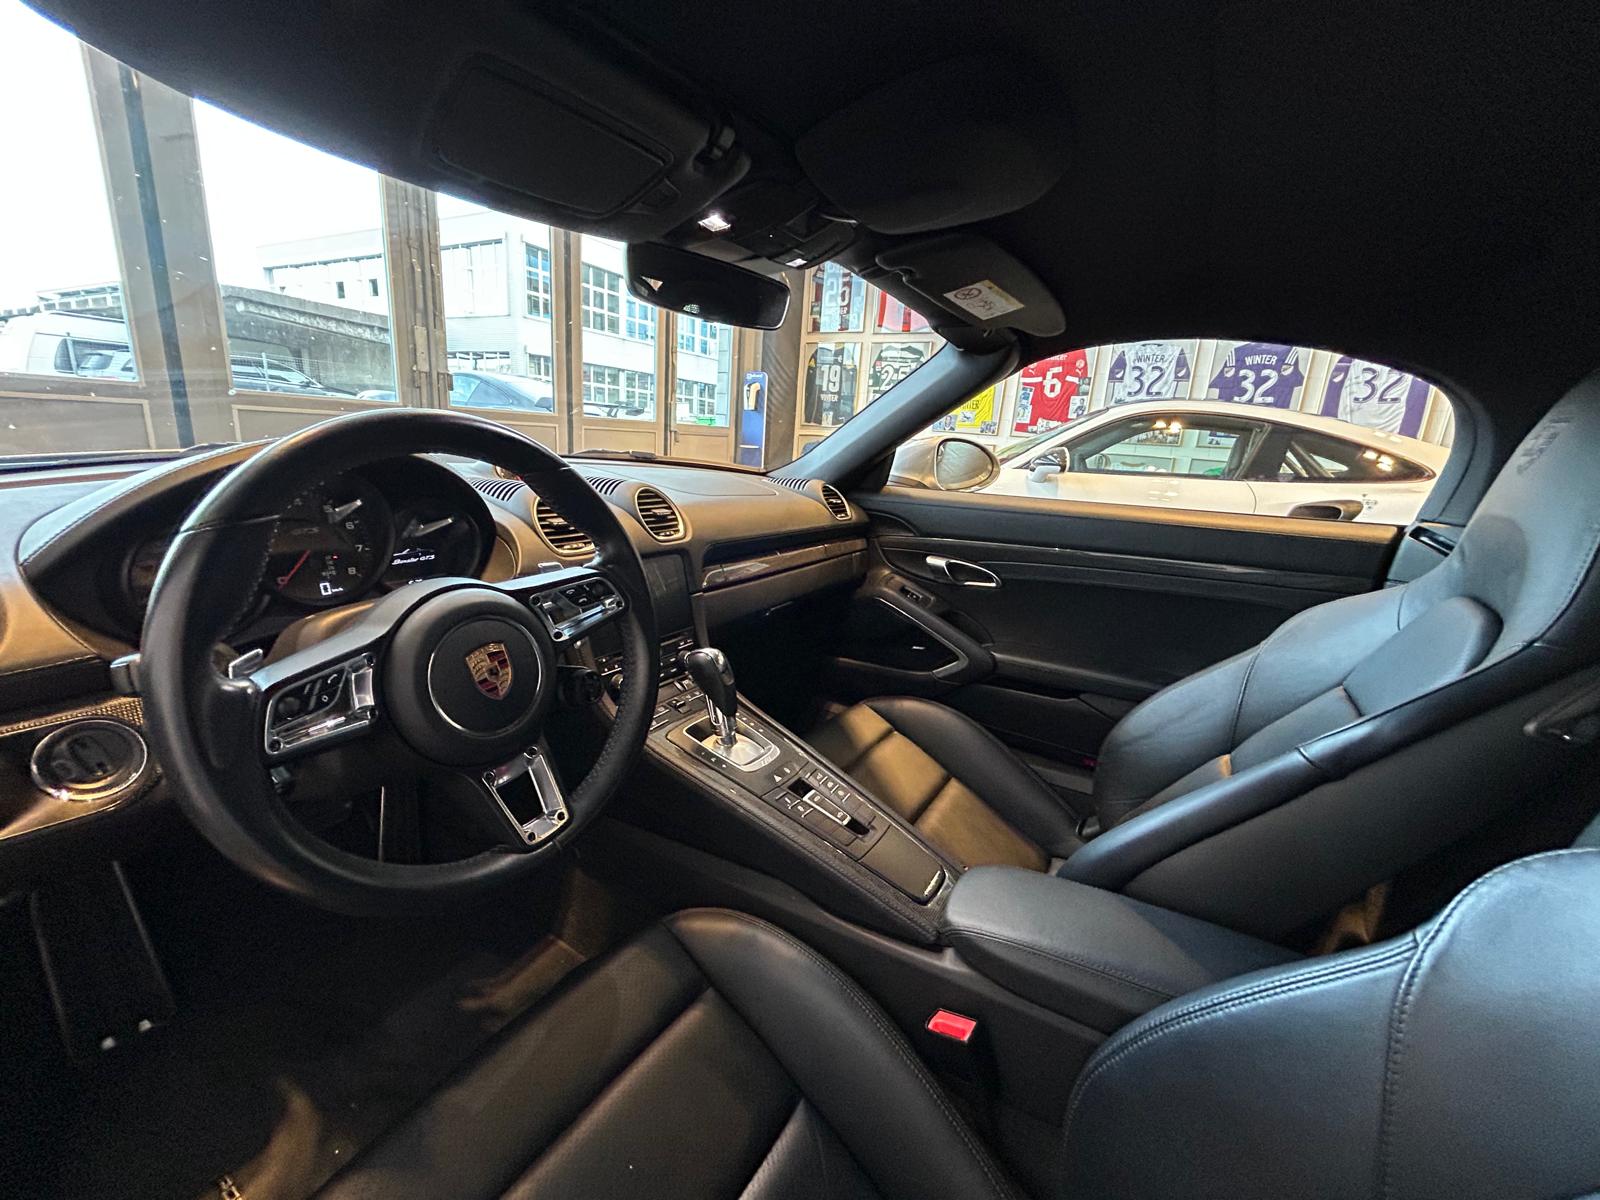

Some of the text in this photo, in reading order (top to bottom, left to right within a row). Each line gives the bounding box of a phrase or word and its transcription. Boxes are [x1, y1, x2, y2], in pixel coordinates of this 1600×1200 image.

[1136, 353, 1166, 363] WINTER
[1245, 354, 1278, 366] WINTER
[821, 364, 841, 392] 19
[1043, 366, 1063, 398] 6
[1127, 366, 1166, 397] 32
[1233, 368, 1279, 404] 32
[1353, 367, 1406, 404] 32
[319, 582, 332, 596] 0
